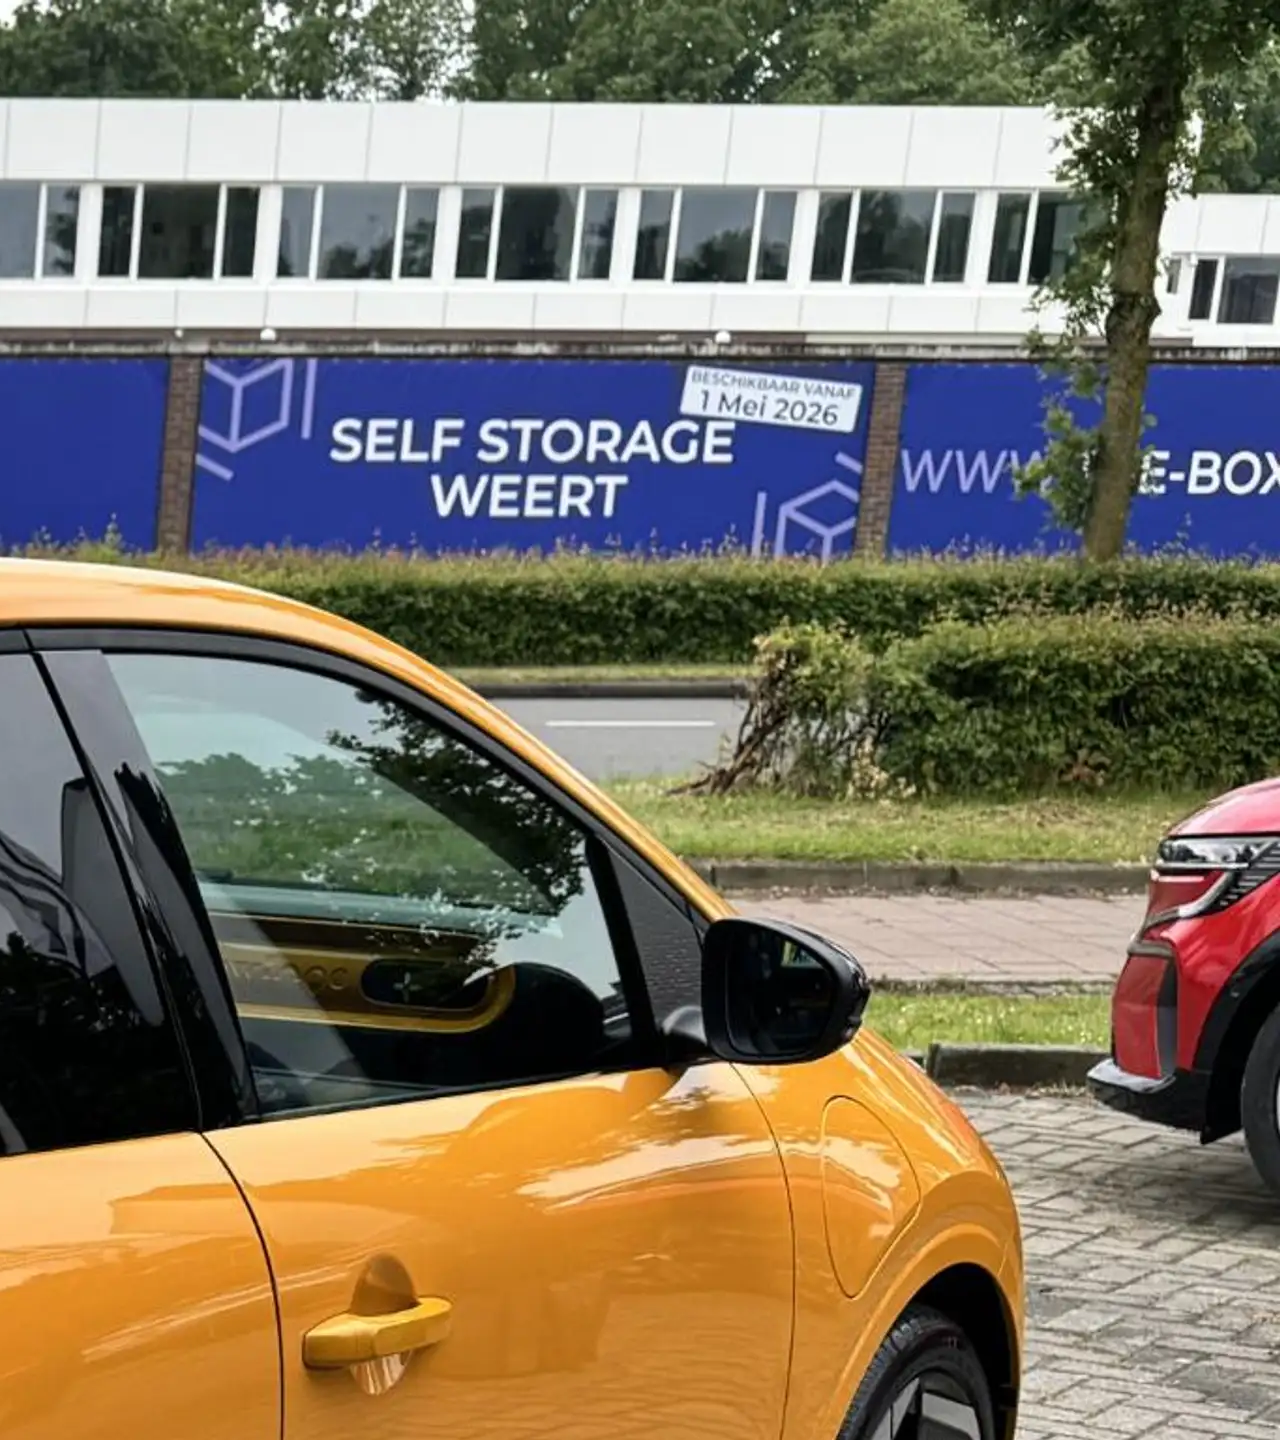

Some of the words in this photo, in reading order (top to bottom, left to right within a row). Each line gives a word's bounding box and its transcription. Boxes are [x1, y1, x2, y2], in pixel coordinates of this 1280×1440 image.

[690, 368, 801, 395] BESCHIKBAAR
[803, 379, 857, 401] VANAF
[700, 389, 710, 412] 1
[717, 391, 768, 419] Mei
[772, 397, 839, 426] 2026
[329, 418, 465, 463] SELF
[476, 418, 736, 464] STORAGE
[430, 473, 628, 518] WEERT
